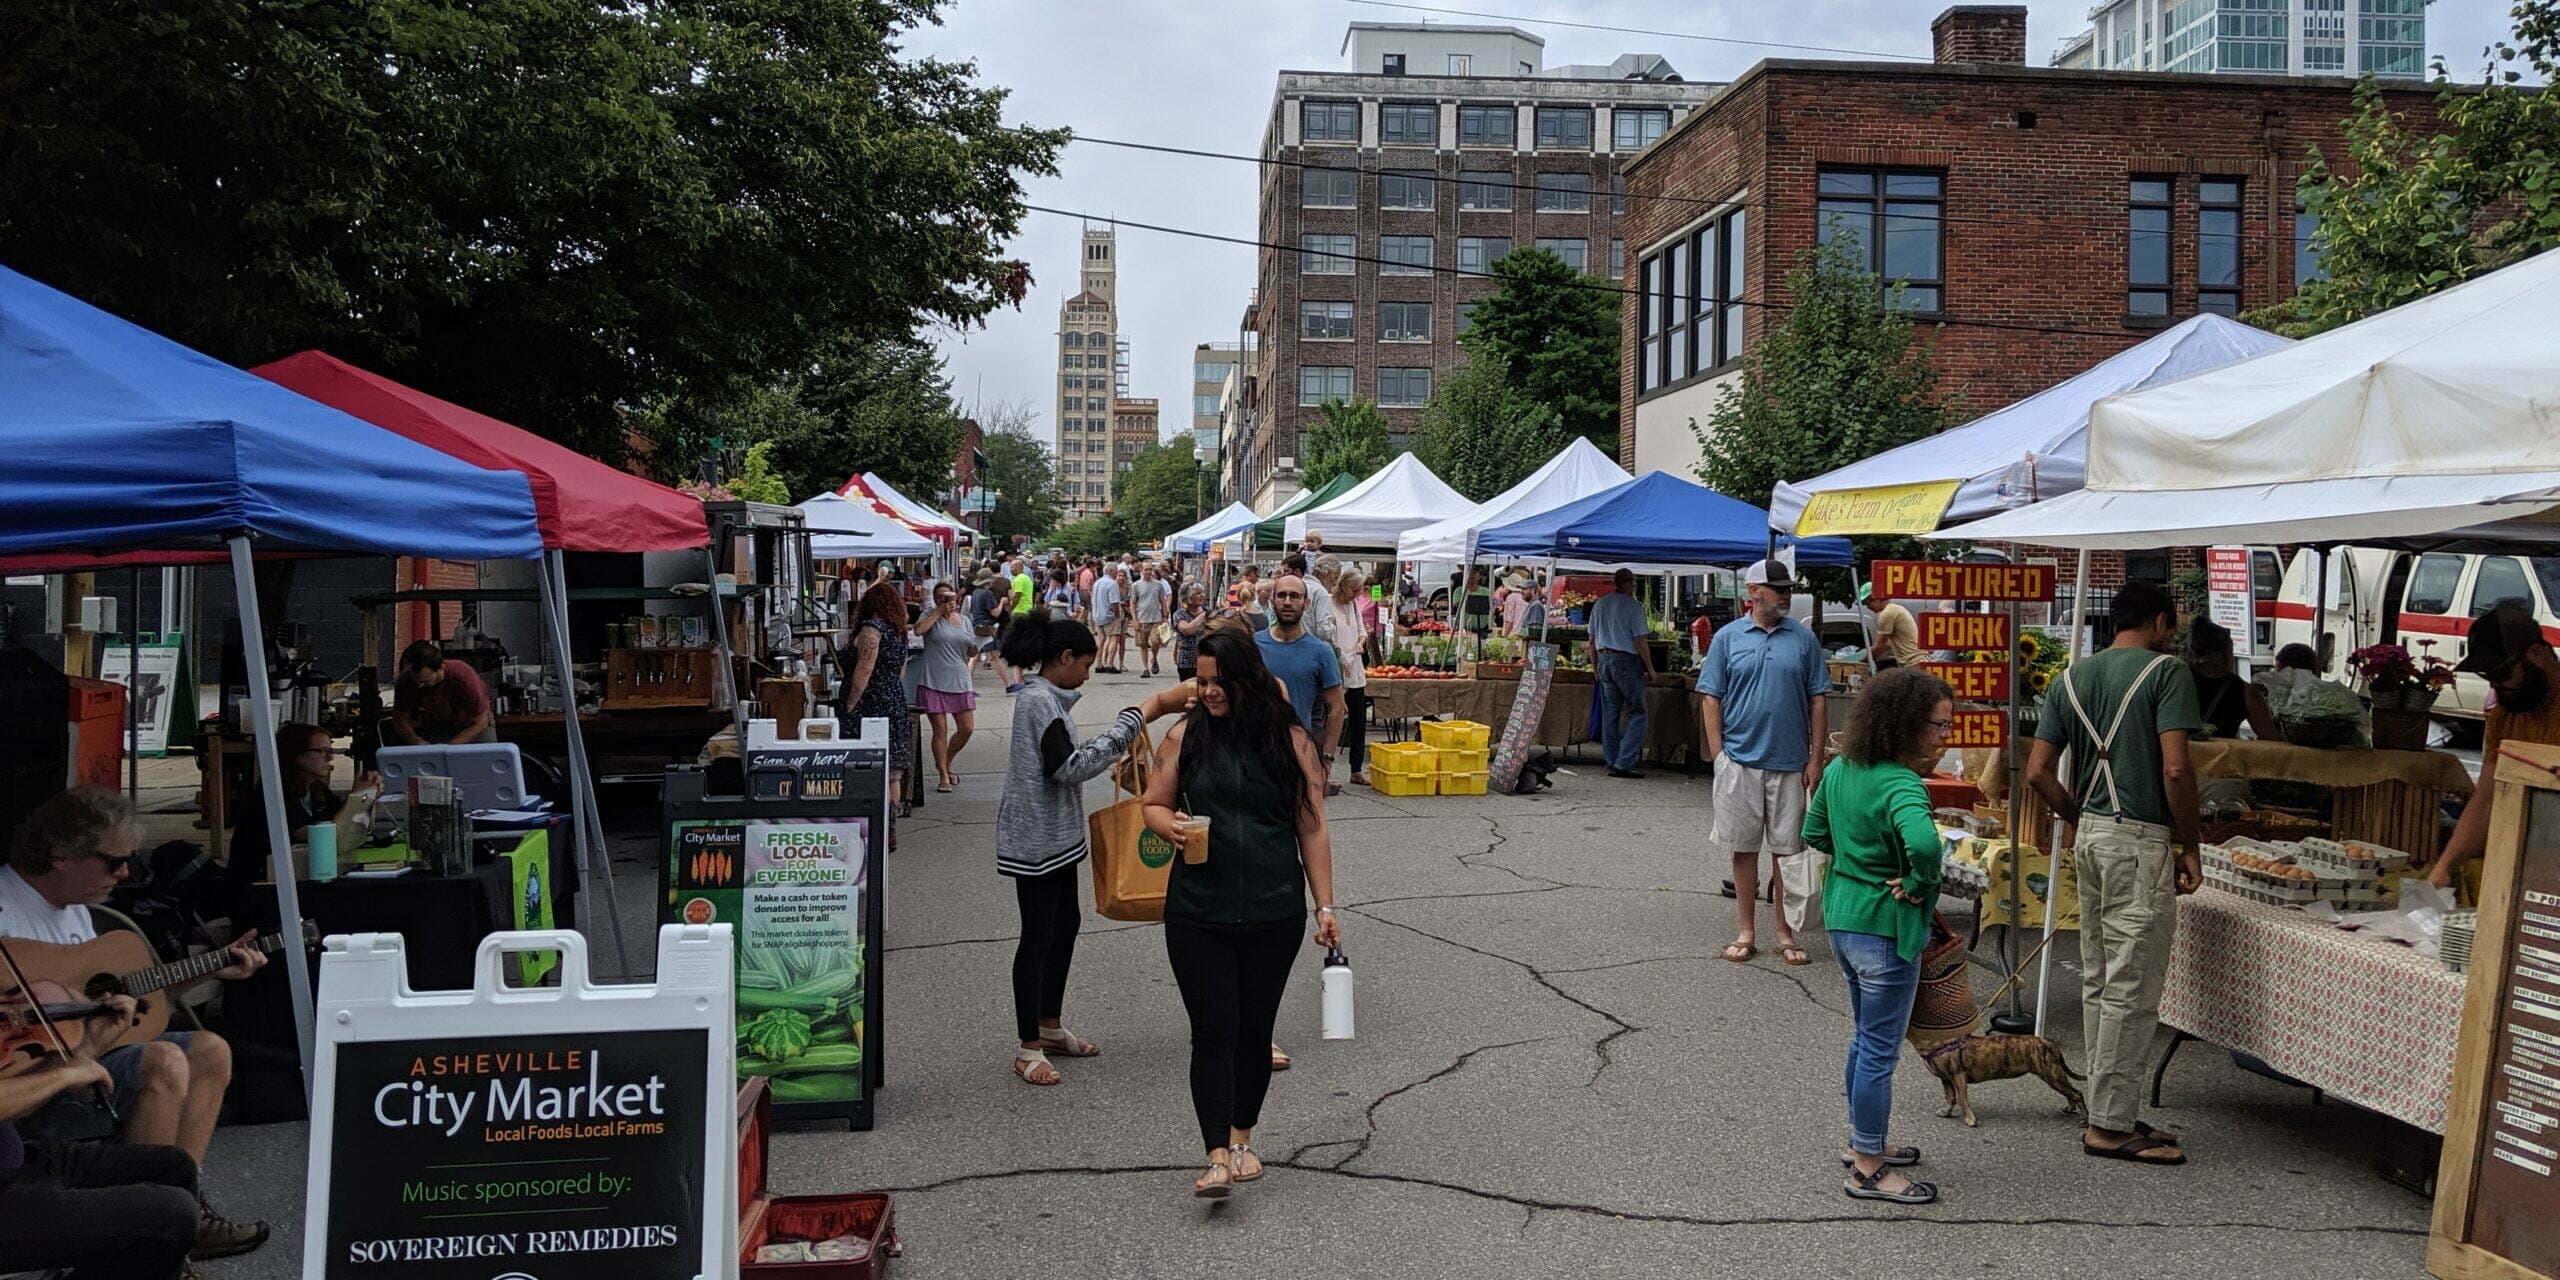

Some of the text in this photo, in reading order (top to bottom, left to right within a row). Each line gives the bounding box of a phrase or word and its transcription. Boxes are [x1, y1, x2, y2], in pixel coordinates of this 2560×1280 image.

[1846, 493, 1881, 519] Farm
[1886, 565, 2041, 598] PASTURED
[1928, 616, 2004, 647] PORK
[1945, 714, 2000, 745] GGS
[811, 751, 850, 767] here!
[685, 828, 741, 845] City Market
[772, 846, 833, 860] LOCAL
[786, 859, 817, 871] FOR
[755, 870, 847, 884] EVERYONE!
[754, 894, 779, 904] Make
[788, 893, 808, 902] cash
[821, 892, 848, 901] token
[754, 903, 847, 914] donation to improve
[801, 914, 815, 923] for
[816, 914, 829, 922] all!
[751, 929, 849, 938] This market doubles tokens
[751, 940, 762, 949] for
[763, 940, 784, 949] SNAP
[785, 940, 811, 949] eligible
[410, 1050, 583, 1077] ASHEVILLE
[374, 1050, 665, 1138] City Market
[486, 1121, 664, 1143] Local Foods Local Farms
[403, 1172, 631, 1204] Music sponsored by:
[349, 1224, 677, 1264] SOVEREIGN REMEDIES
